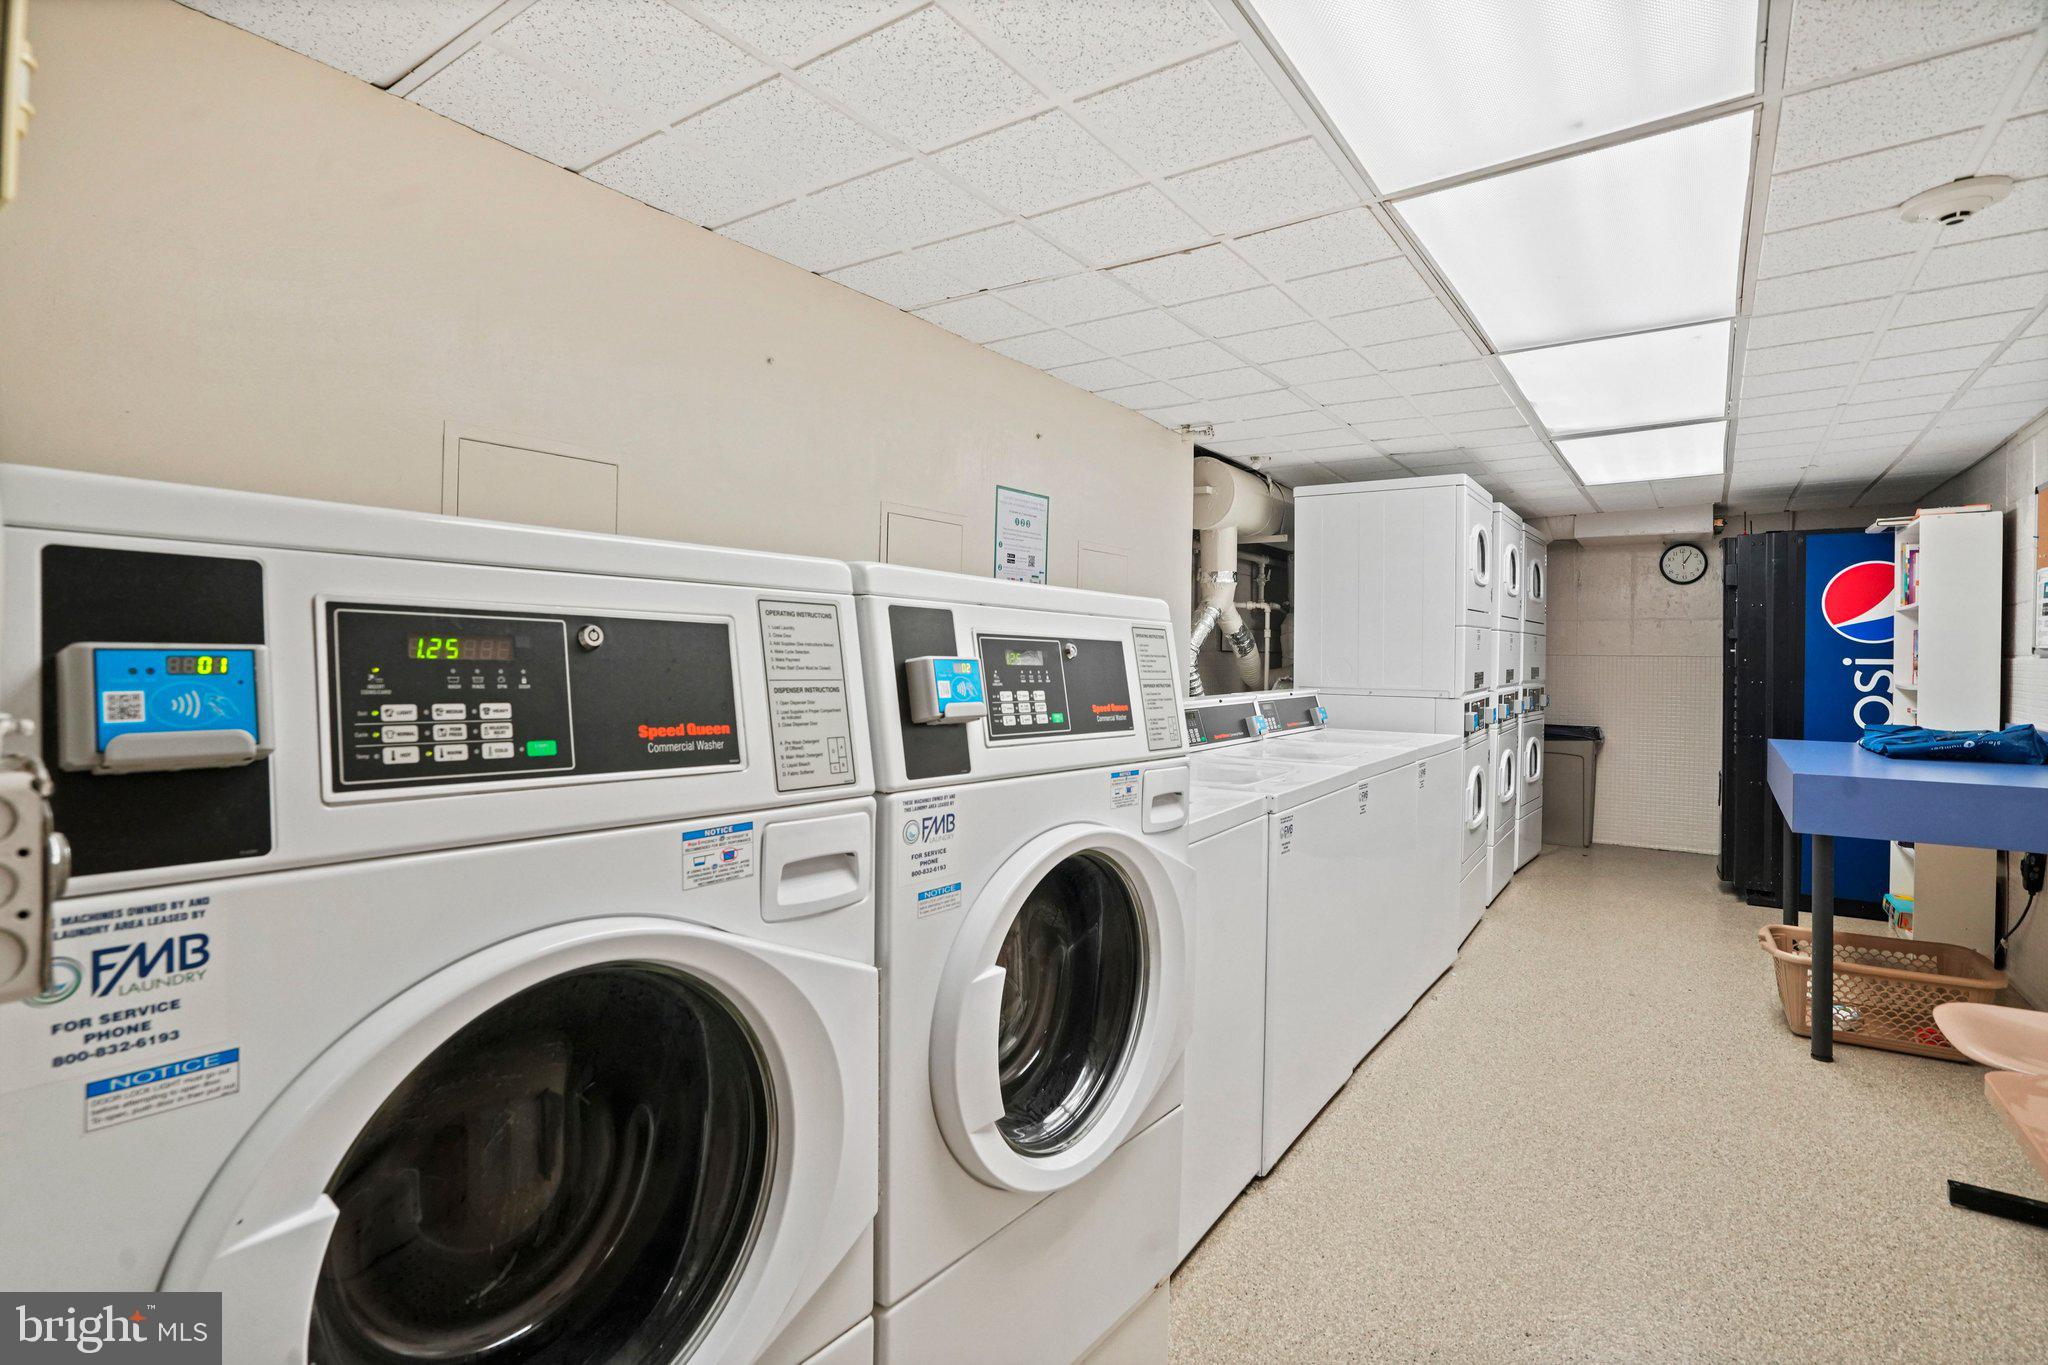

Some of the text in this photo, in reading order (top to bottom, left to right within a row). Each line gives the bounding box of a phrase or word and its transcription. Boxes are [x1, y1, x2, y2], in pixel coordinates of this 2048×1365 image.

[765, 609, 795, 617] OPERATING
[417, 637, 459, 660] 1.25
[197, 656, 228, 674] 01
[638, 723, 730, 740] Speed Queen
[647, 740, 724, 753] Commercial Washer
[704, 826, 734, 836] NOTICE
[922, 813, 956, 843] FMB
[920, 858, 938, 866] PHONE
[924, 848, 947, 858] SERVICE
[911, 864, 947, 877] 800-832-6193
[924, 884, 956, 898] NOTICE
[60, 908, 123, 926] MACHINES
[127, 902, 166, 917] OWNED
[171, 900, 184, 910] BY
[189, 897, 210, 907] AND
[54, 910, 205, 940] LAUNDRY AREA LEASED BY
[91, 933, 210, 998] FMB
[119, 970, 208, 996] LAUNDRY
[51, 999, 181, 1035] FOR SERVICE
[84, 1020, 152, 1044] PHONE
[52, 1030, 180, 1067] 800-832-6193
[110, 1054, 221, 1090] NOTICE
